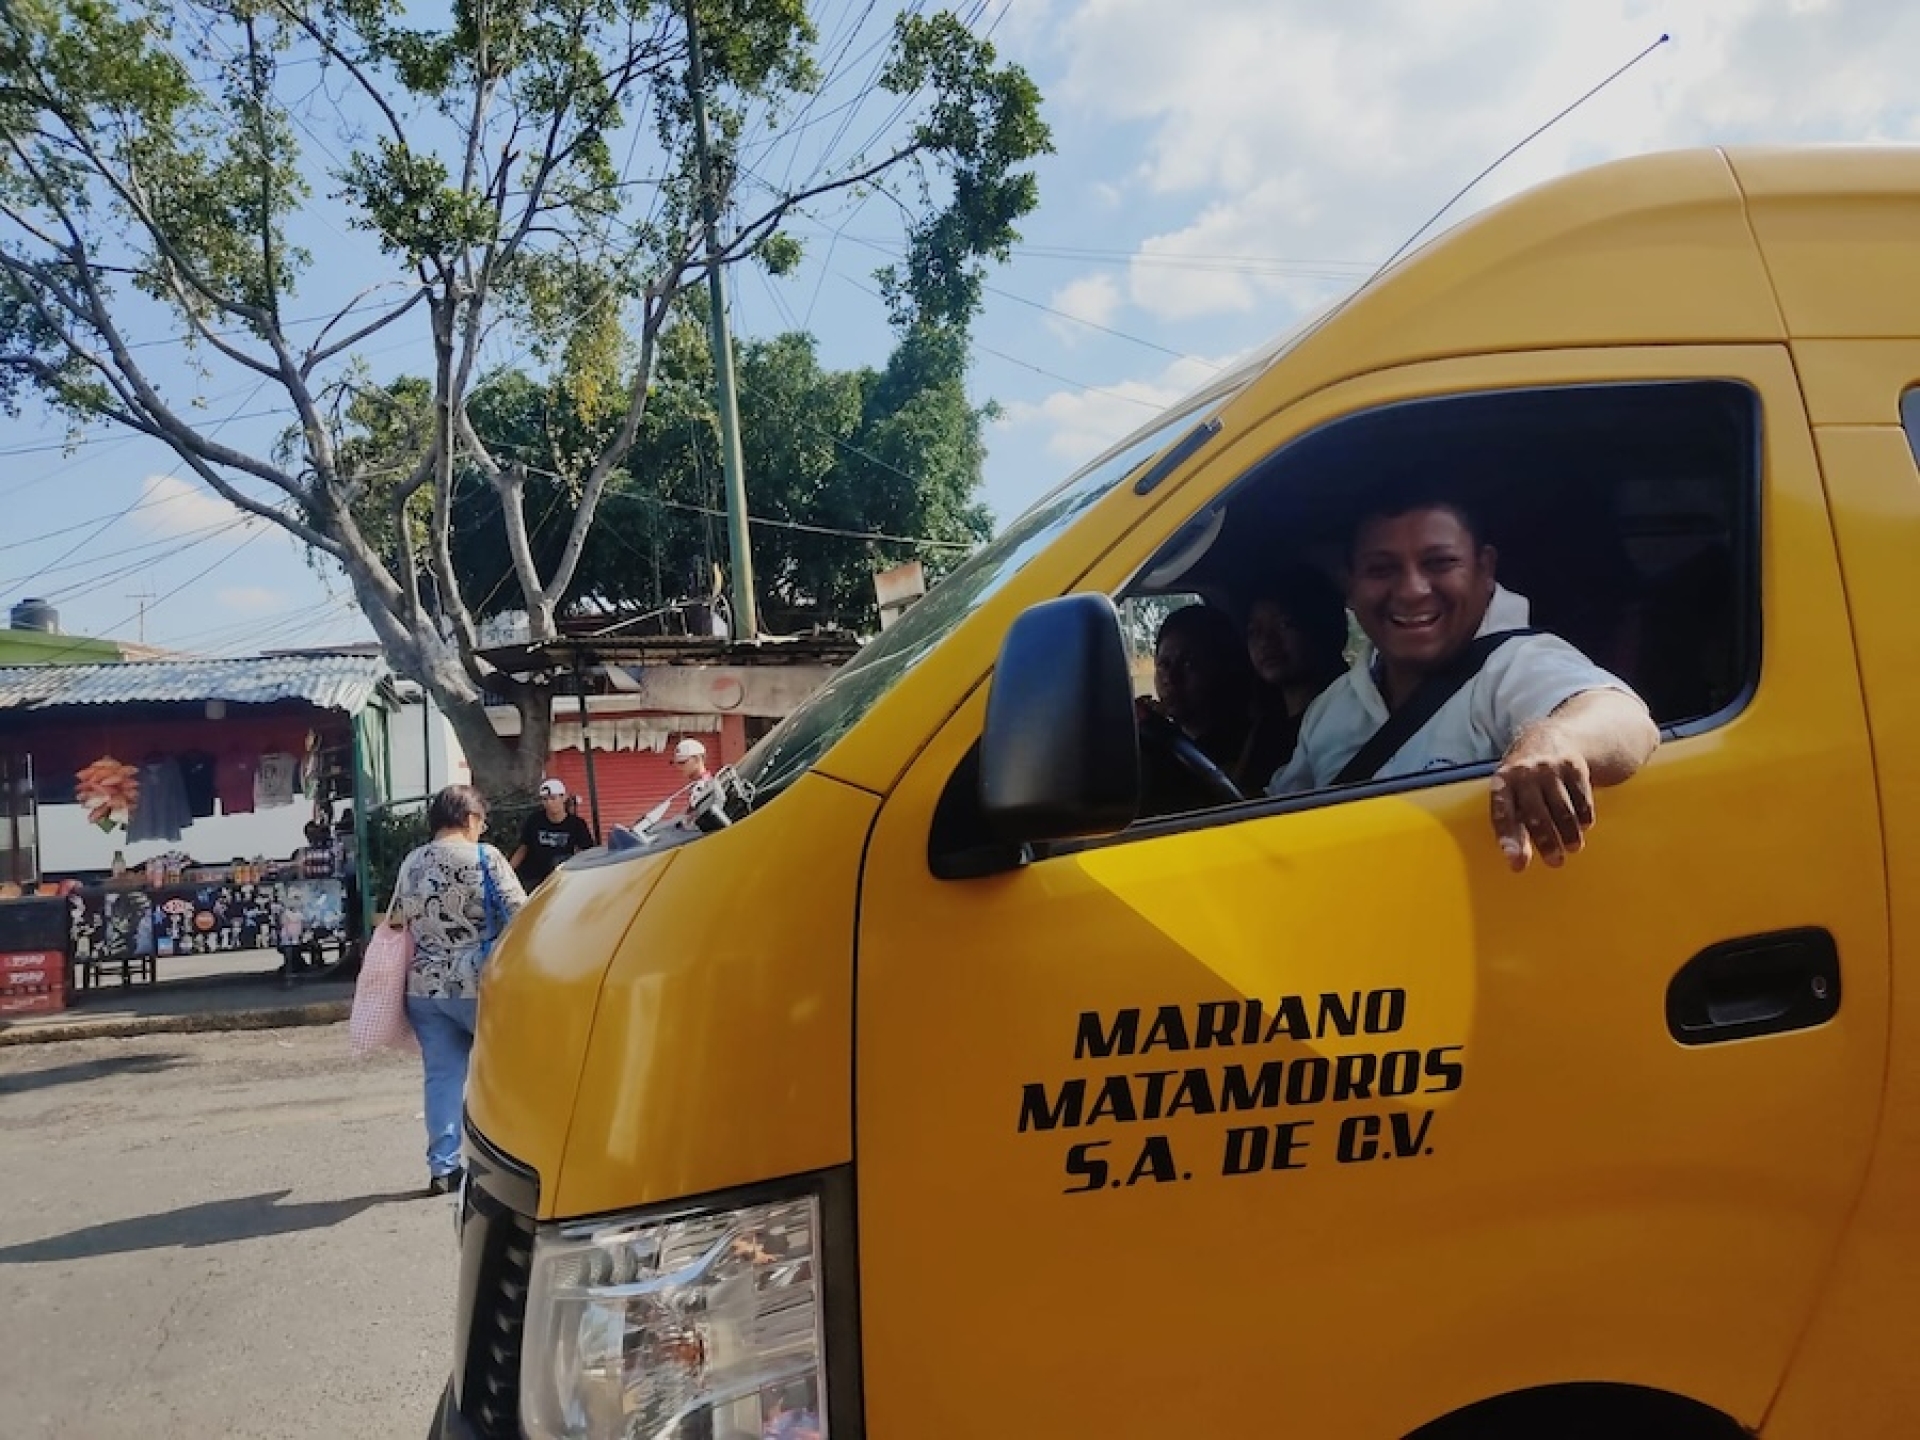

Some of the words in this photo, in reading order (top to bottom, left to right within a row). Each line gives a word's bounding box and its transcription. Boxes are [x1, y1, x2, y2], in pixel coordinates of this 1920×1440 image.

[1074, 988, 1406, 1060] MARIANO
[1017, 1046, 1464, 1133] MATAMOROS
[1063, 1135, 1193, 1194] S.A.
[1221, 1119, 1315, 1176] DE
[1336, 1109, 1435, 1164] C.V.
